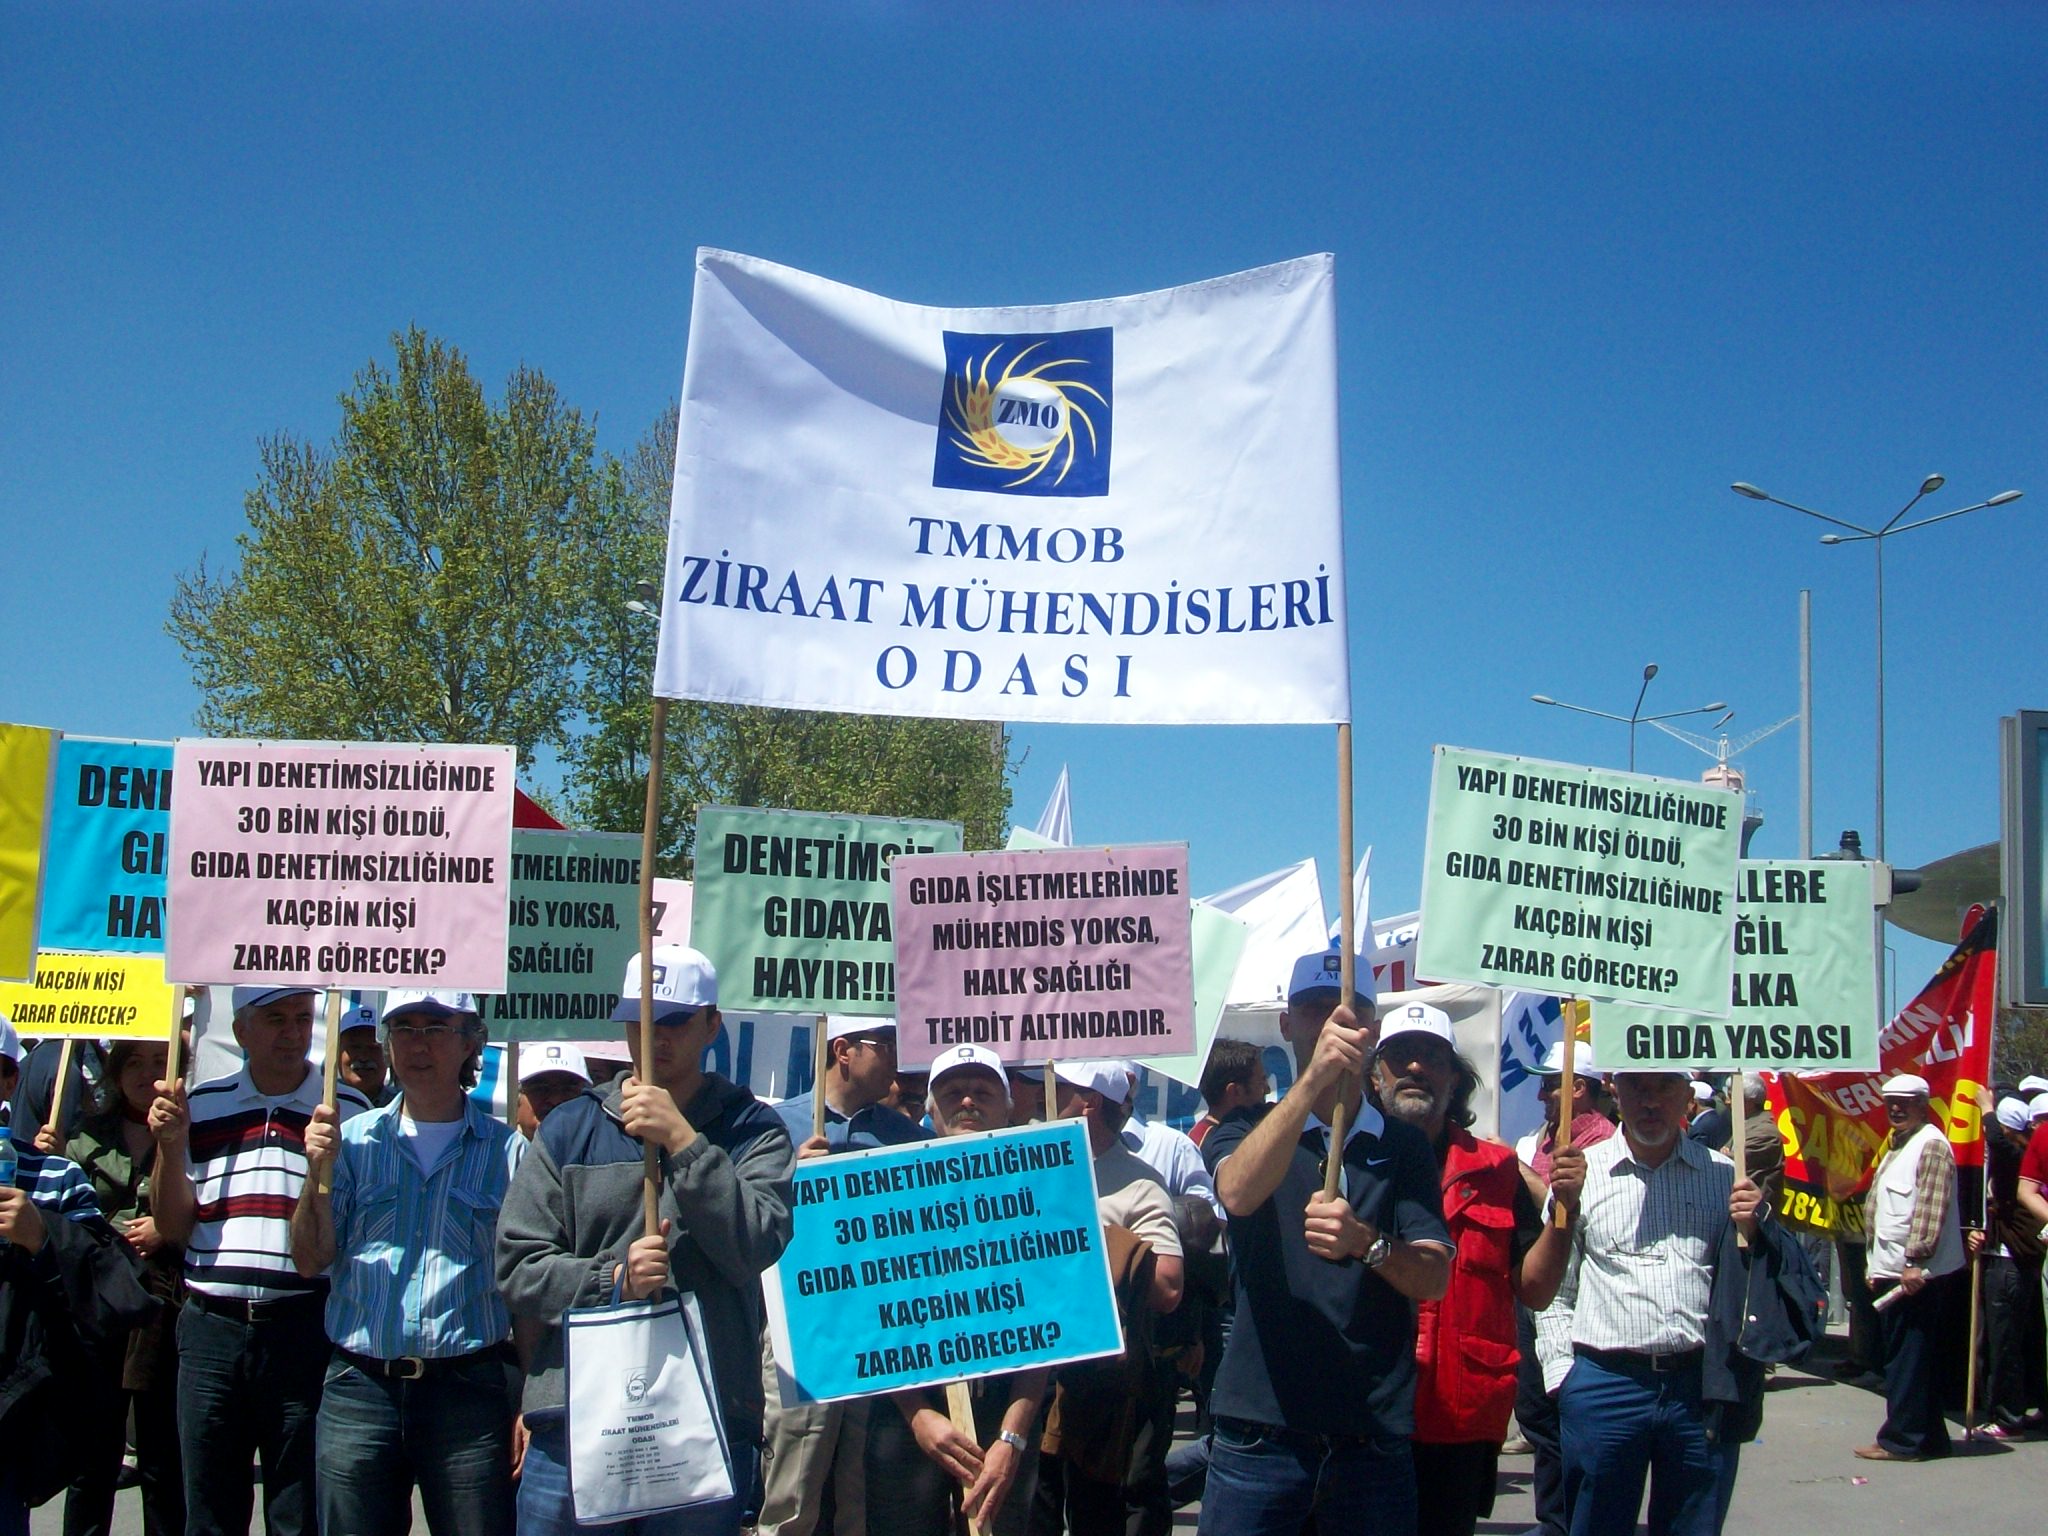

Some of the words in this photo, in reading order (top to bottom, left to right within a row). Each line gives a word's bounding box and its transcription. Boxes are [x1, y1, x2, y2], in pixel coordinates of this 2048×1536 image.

[997, 398, 1060, 430] ZMO
[908, 516, 1126, 564] TMMOB
[678, 549, 884, 624] ZİRAAT
[899, 563, 1335, 637] MÜHENDİSLERİ
[876, 645, 1133, 698] ODASI
[198, 760, 251, 787] YAPI
[257, 758, 495, 792] DENETİMSİZLİĞİNDE
[1456, 764, 1506, 796] YAPI
[1512, 773, 1727, 830] DENETİMSİZLİĞİNDE
[238, 806, 270, 834] 30
[277, 803, 319, 835] BİN
[326, 804, 376, 840] KİŞİ
[383, 805, 450, 839] ÖLDÜ,
[1492, 813, 1522, 842] 30
[1528, 817, 1568, 849] BİN
[1573, 823, 1619, 859] KİŞİ
[1624, 829, 1685, 869] ÖLDÜ,
[121, 830, 168, 875] GI
[191, 851, 250, 879] GIDA
[257, 850, 495, 884] DENETİMSİZLİĞİNDE
[723, 833, 935, 883] DENETİMS
[910, 875, 971, 905] GIDA
[977, 865, 1179, 907] İŞLETMELERİNDE
[1446, 851, 1501, 883] GIDA
[1507, 859, 1722, 915] DENETİMSİZLİĞİNDE
[106, 894, 167, 939] HA
[266, 896, 359, 931] KAÇBİN
[365, 896, 416, 933] KİŞİ
[545, 900, 620, 932] YOKSA,
[764, 895, 893, 942] GIDAYA
[932, 914, 1065, 951] MÜHENDİS
[1070, 915, 1160, 946] YOKSA,
[1513, 904, 1601, 939] KAÇBİN
[1606, 915, 1653, 950] KİŞİ
[233, 944, 311, 972] ZARAR
[317, 941, 447, 975] GÖRECEK?
[508, 941, 593, 975] SAĞLIĞI
[963, 967, 1028, 996] HALK
[1033, 958, 1132, 994] SAĞLIĞI
[1480, 943, 1555, 978] ZARAR
[1561, 952, 1679, 993] GÖRECEK?
[35, 967, 91, 994] KAÇBİN
[93, 968, 125, 995] KİŞİ
[11, 1003, 56, 1023] ZARAR
[59, 1001, 137, 1026] GÖRECEK?
[925, 1010, 1014, 1045] TEHDİT
[1020, 1008, 1172, 1041] ALTINDADIR.
[1626, 1024, 1716, 1060] GIDA
[1724, 1024, 1851, 1060] YASASI
[845, 1140, 1075, 1199] DENETİMSİZLİĞİNDE
[834, 1216, 867, 1245] 30
[874, 1207, 914, 1240] BİN
[921, 1196, 968, 1233] KİŞİ
[974, 1187, 1041, 1222] ÖLDÜ,
[797, 1263, 856, 1297] GIDA
[861, 1227, 1091, 1286] DENETİMSİZLİĞİNDE
[878, 1289, 971, 1329] KAÇBİN
[976, 1277, 1025, 1313] KİŞİ
[855, 1341, 934, 1379] ZARAR
[939, 1321, 1062, 1366] GÖRECEK?
